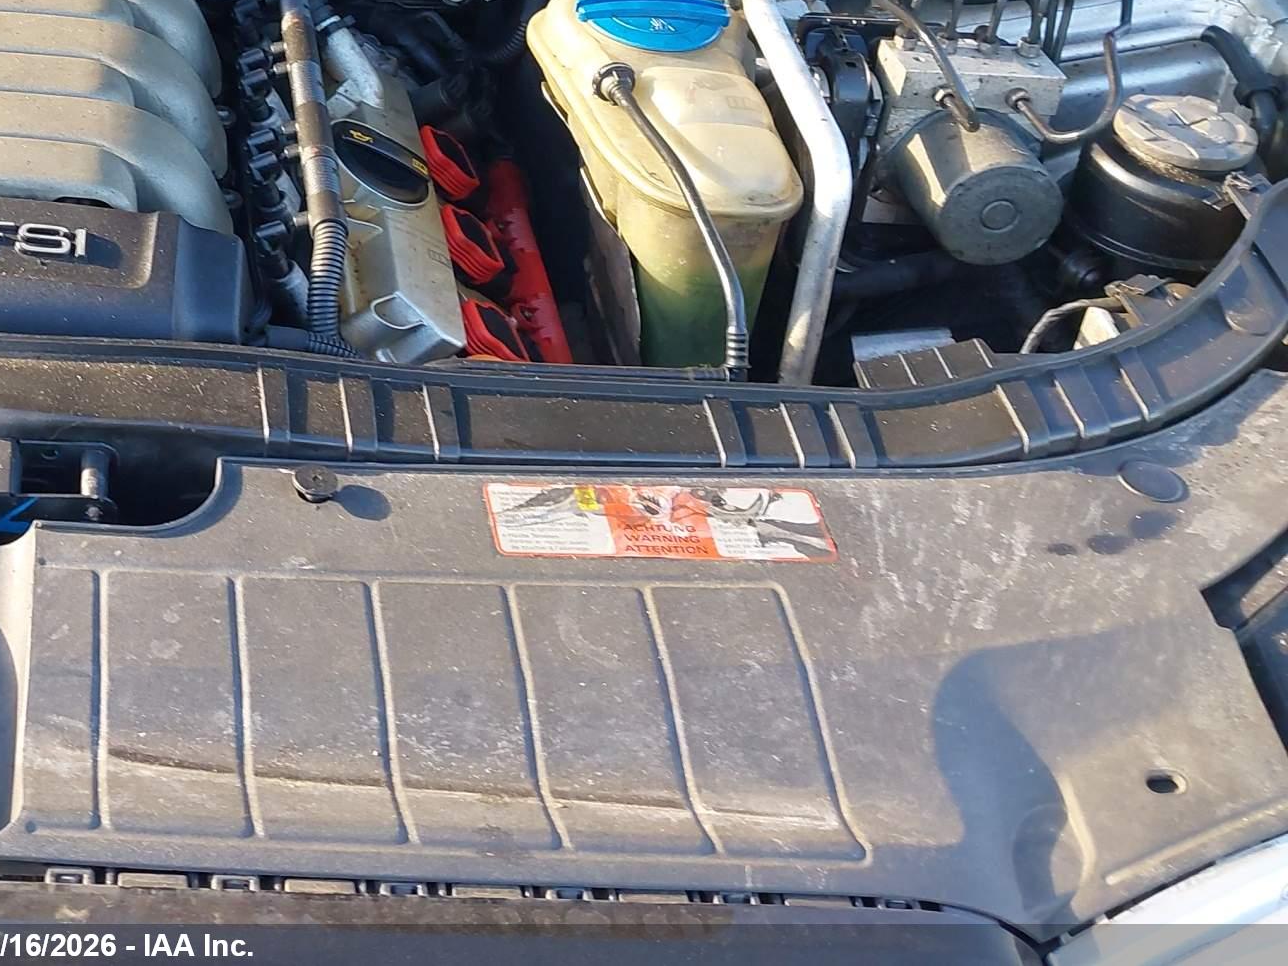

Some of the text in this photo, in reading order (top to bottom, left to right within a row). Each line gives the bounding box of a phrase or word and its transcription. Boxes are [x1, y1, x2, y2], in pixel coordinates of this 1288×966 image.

[623, 523, 697, 533] ACHTUNG
[625, 534, 701, 544] WARNING
[624, 545, 709, 555] ATTENTION
